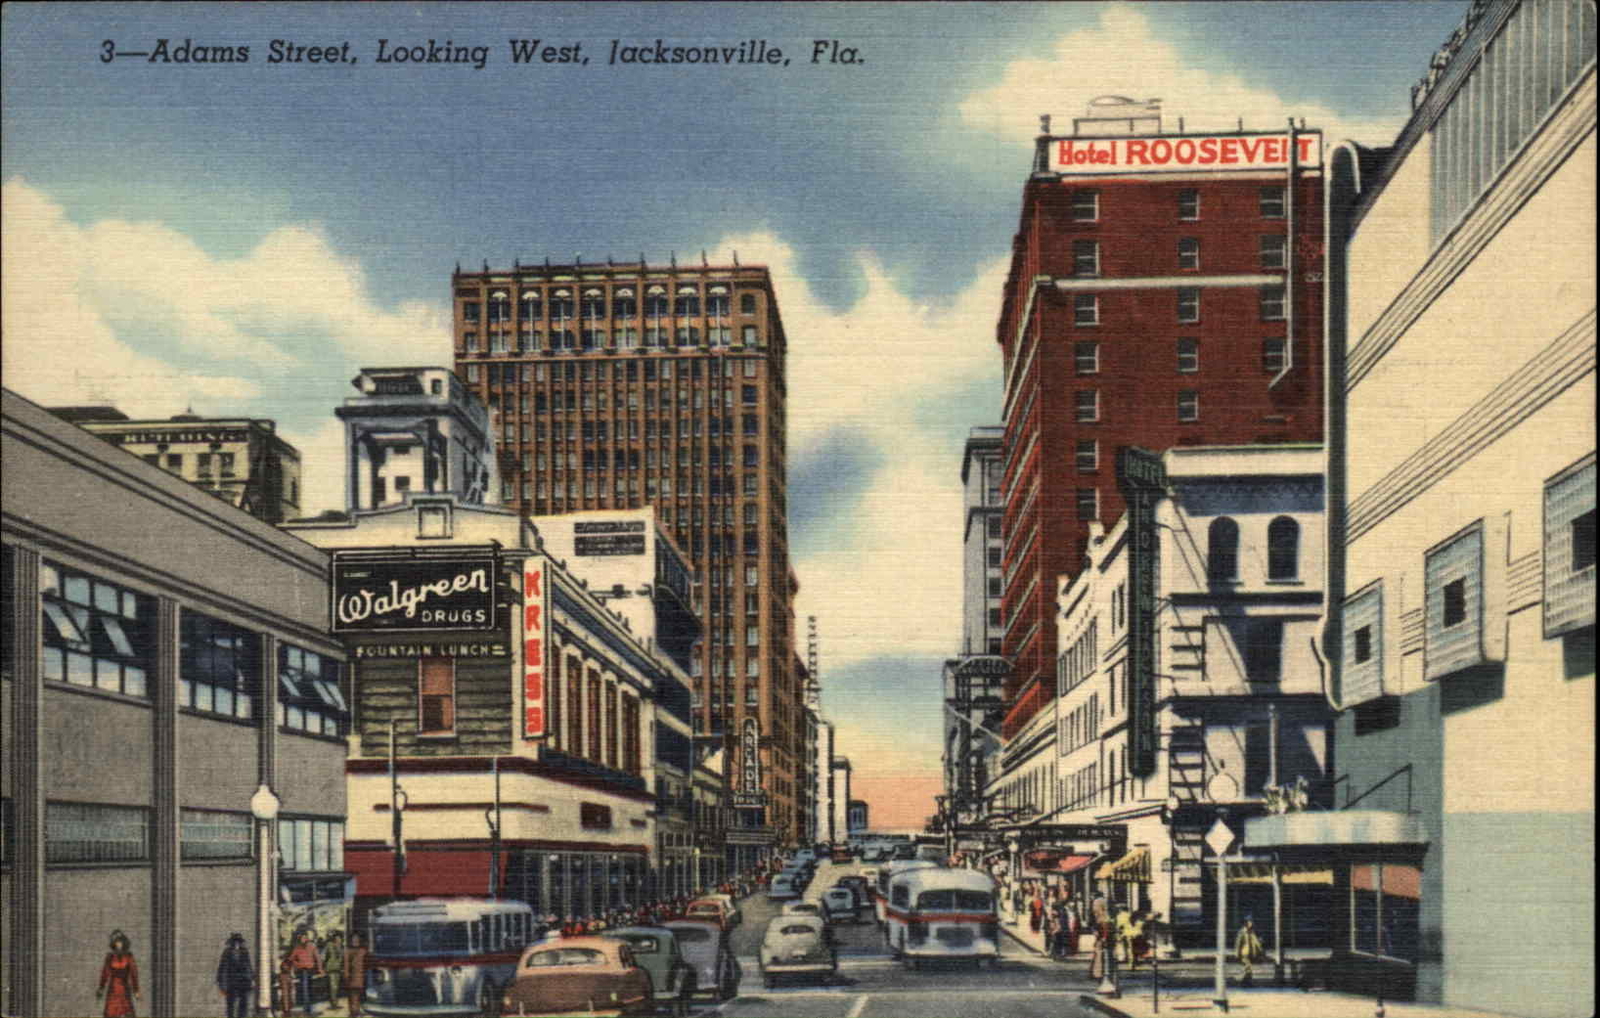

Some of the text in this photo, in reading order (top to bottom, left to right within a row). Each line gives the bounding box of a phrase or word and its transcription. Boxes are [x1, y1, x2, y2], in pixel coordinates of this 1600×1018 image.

[1057, 139, 1118, 166] Hotel
[338, 568, 490, 624] Walgreen
[421, 609, 486, 623] DRUGS
[355, 643, 490, 658] FOUNTAIN LUNCH
[524, 570, 542, 735] KRESS
